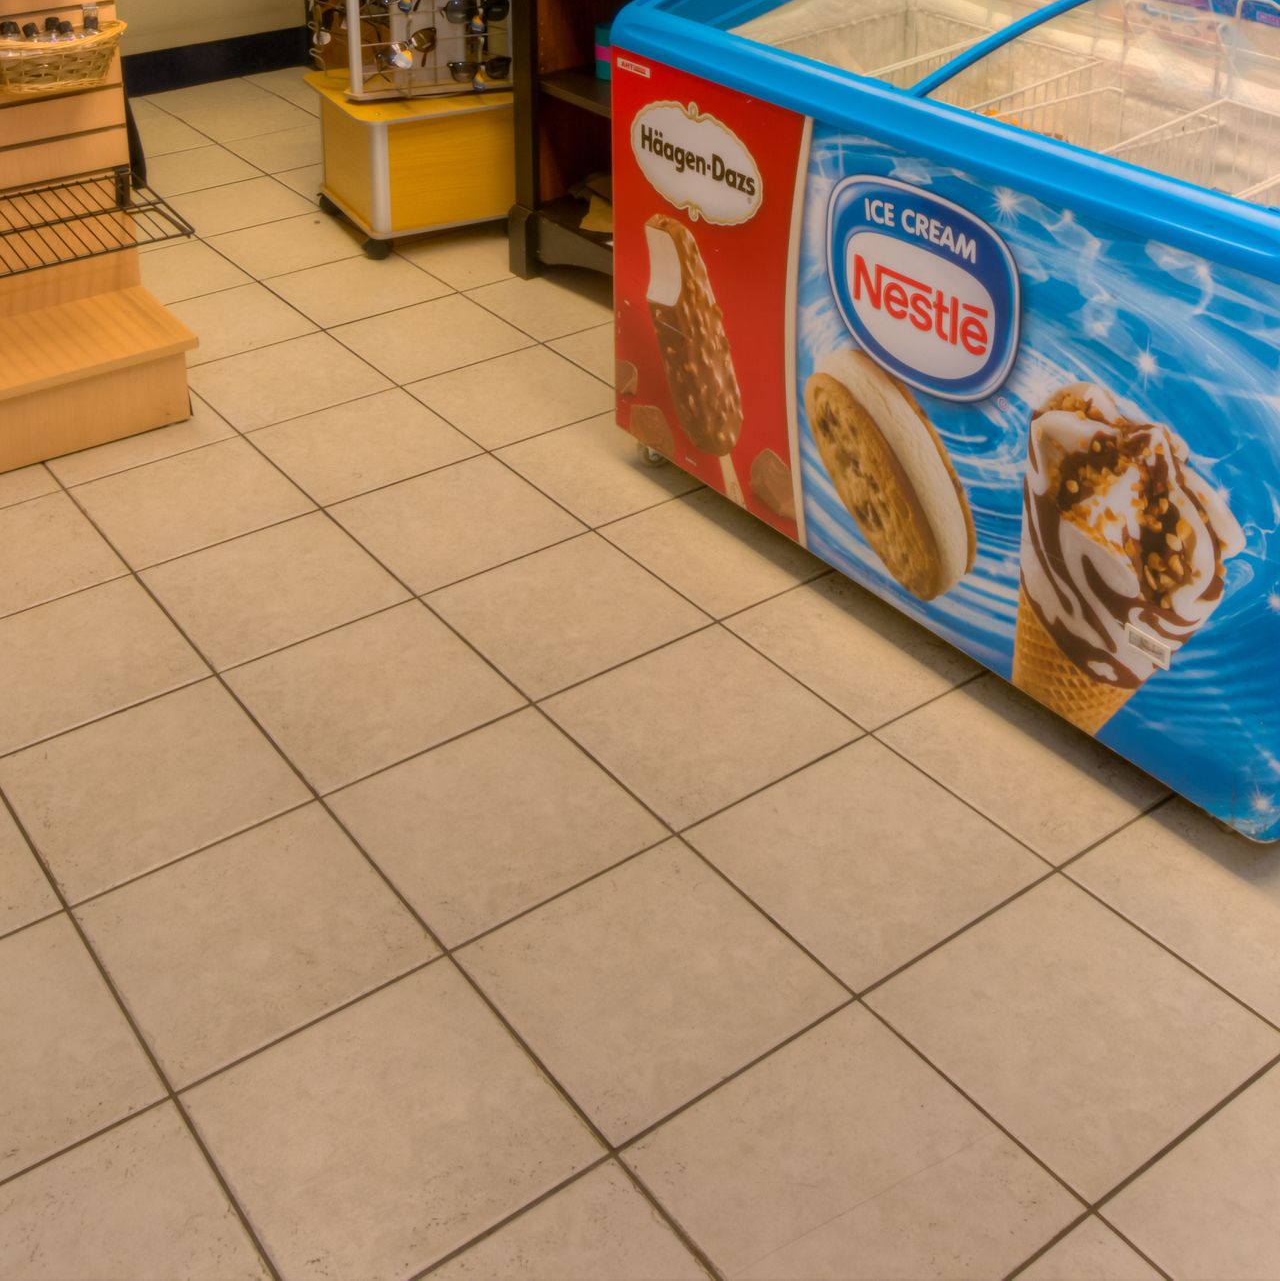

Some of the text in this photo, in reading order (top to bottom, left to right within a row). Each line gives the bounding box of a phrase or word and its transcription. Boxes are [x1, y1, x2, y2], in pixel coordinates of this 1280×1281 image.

[641, 124, 756, 196] Häagen-Dazs
[864, 198, 977, 264] ICE CREAM
